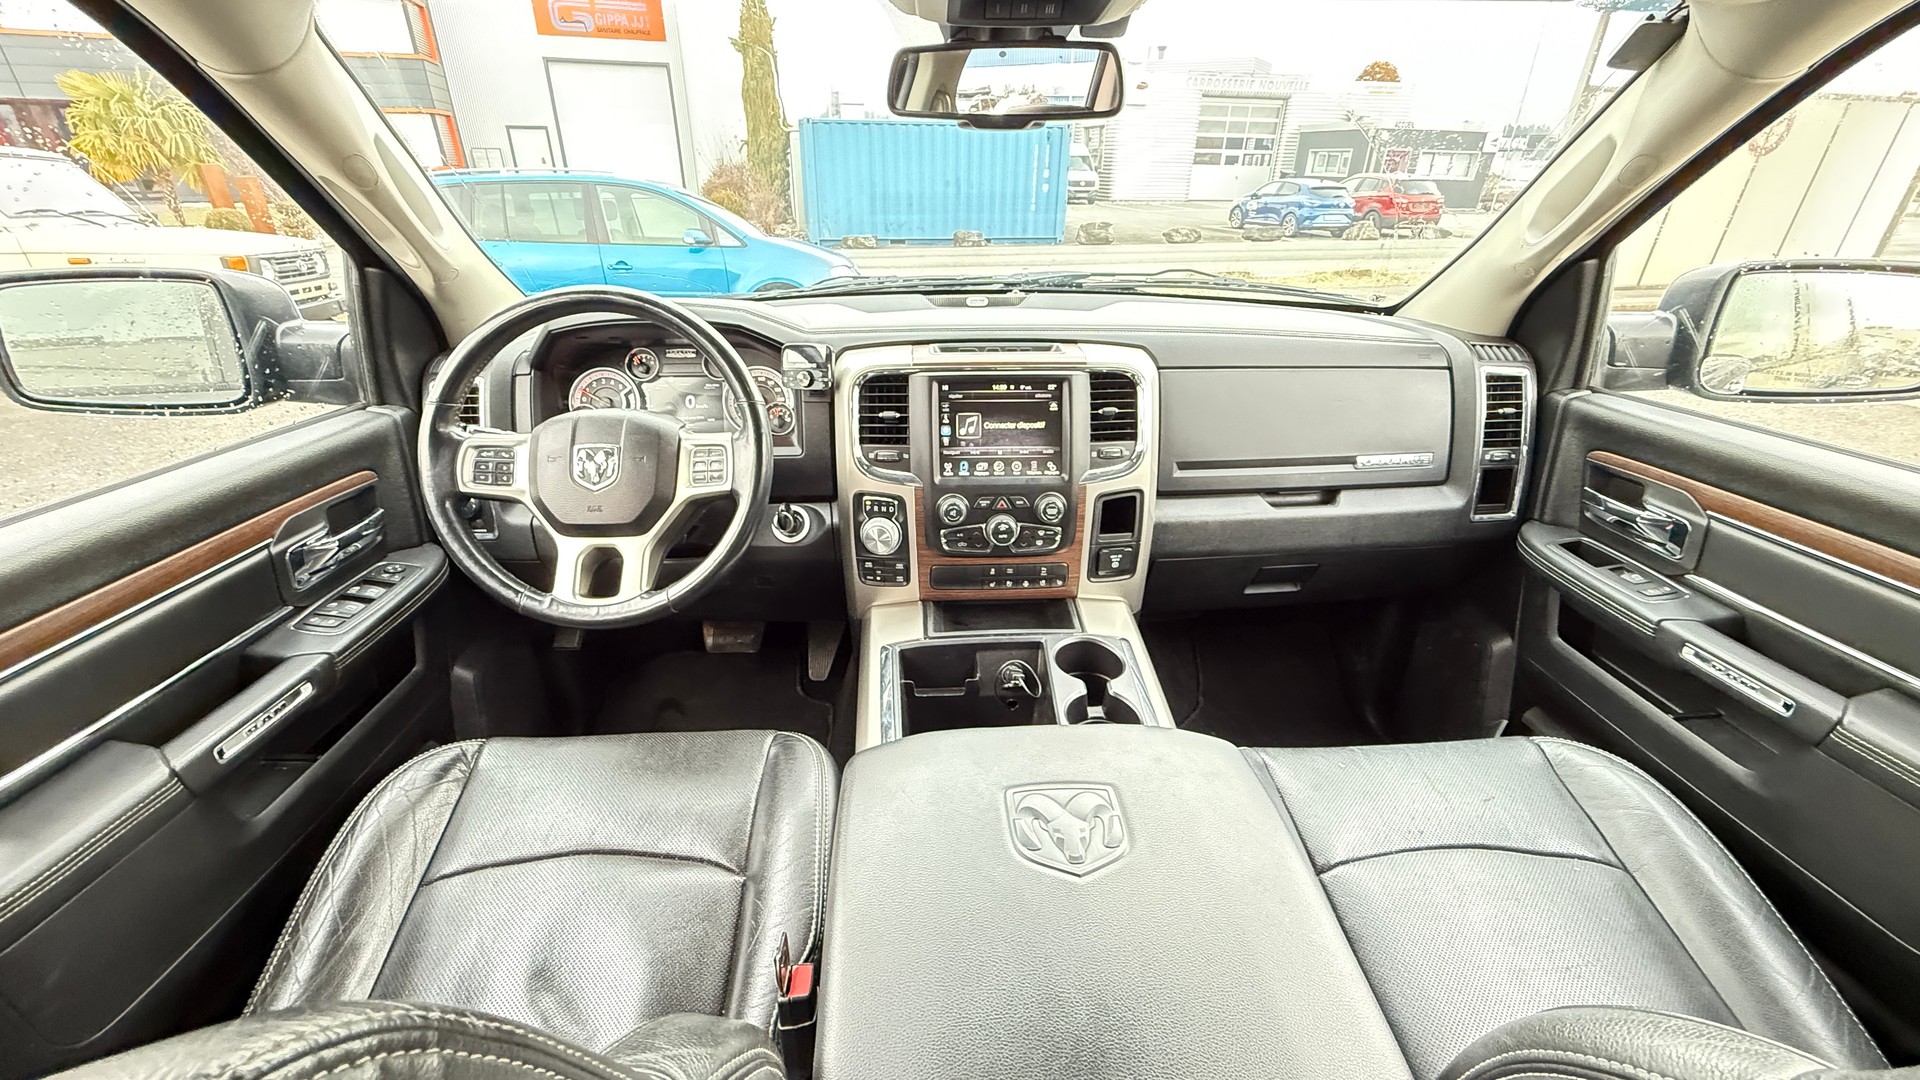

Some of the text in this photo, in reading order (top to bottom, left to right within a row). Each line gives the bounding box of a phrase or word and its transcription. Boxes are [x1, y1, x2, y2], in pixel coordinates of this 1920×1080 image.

[595, 12, 629, 26] GIPPA
[1186, 76, 1311, 91] CARROSSERIE NOUVELLE
[685, 394, 696, 409] 0
[242, 700, 288, 737] RAM
